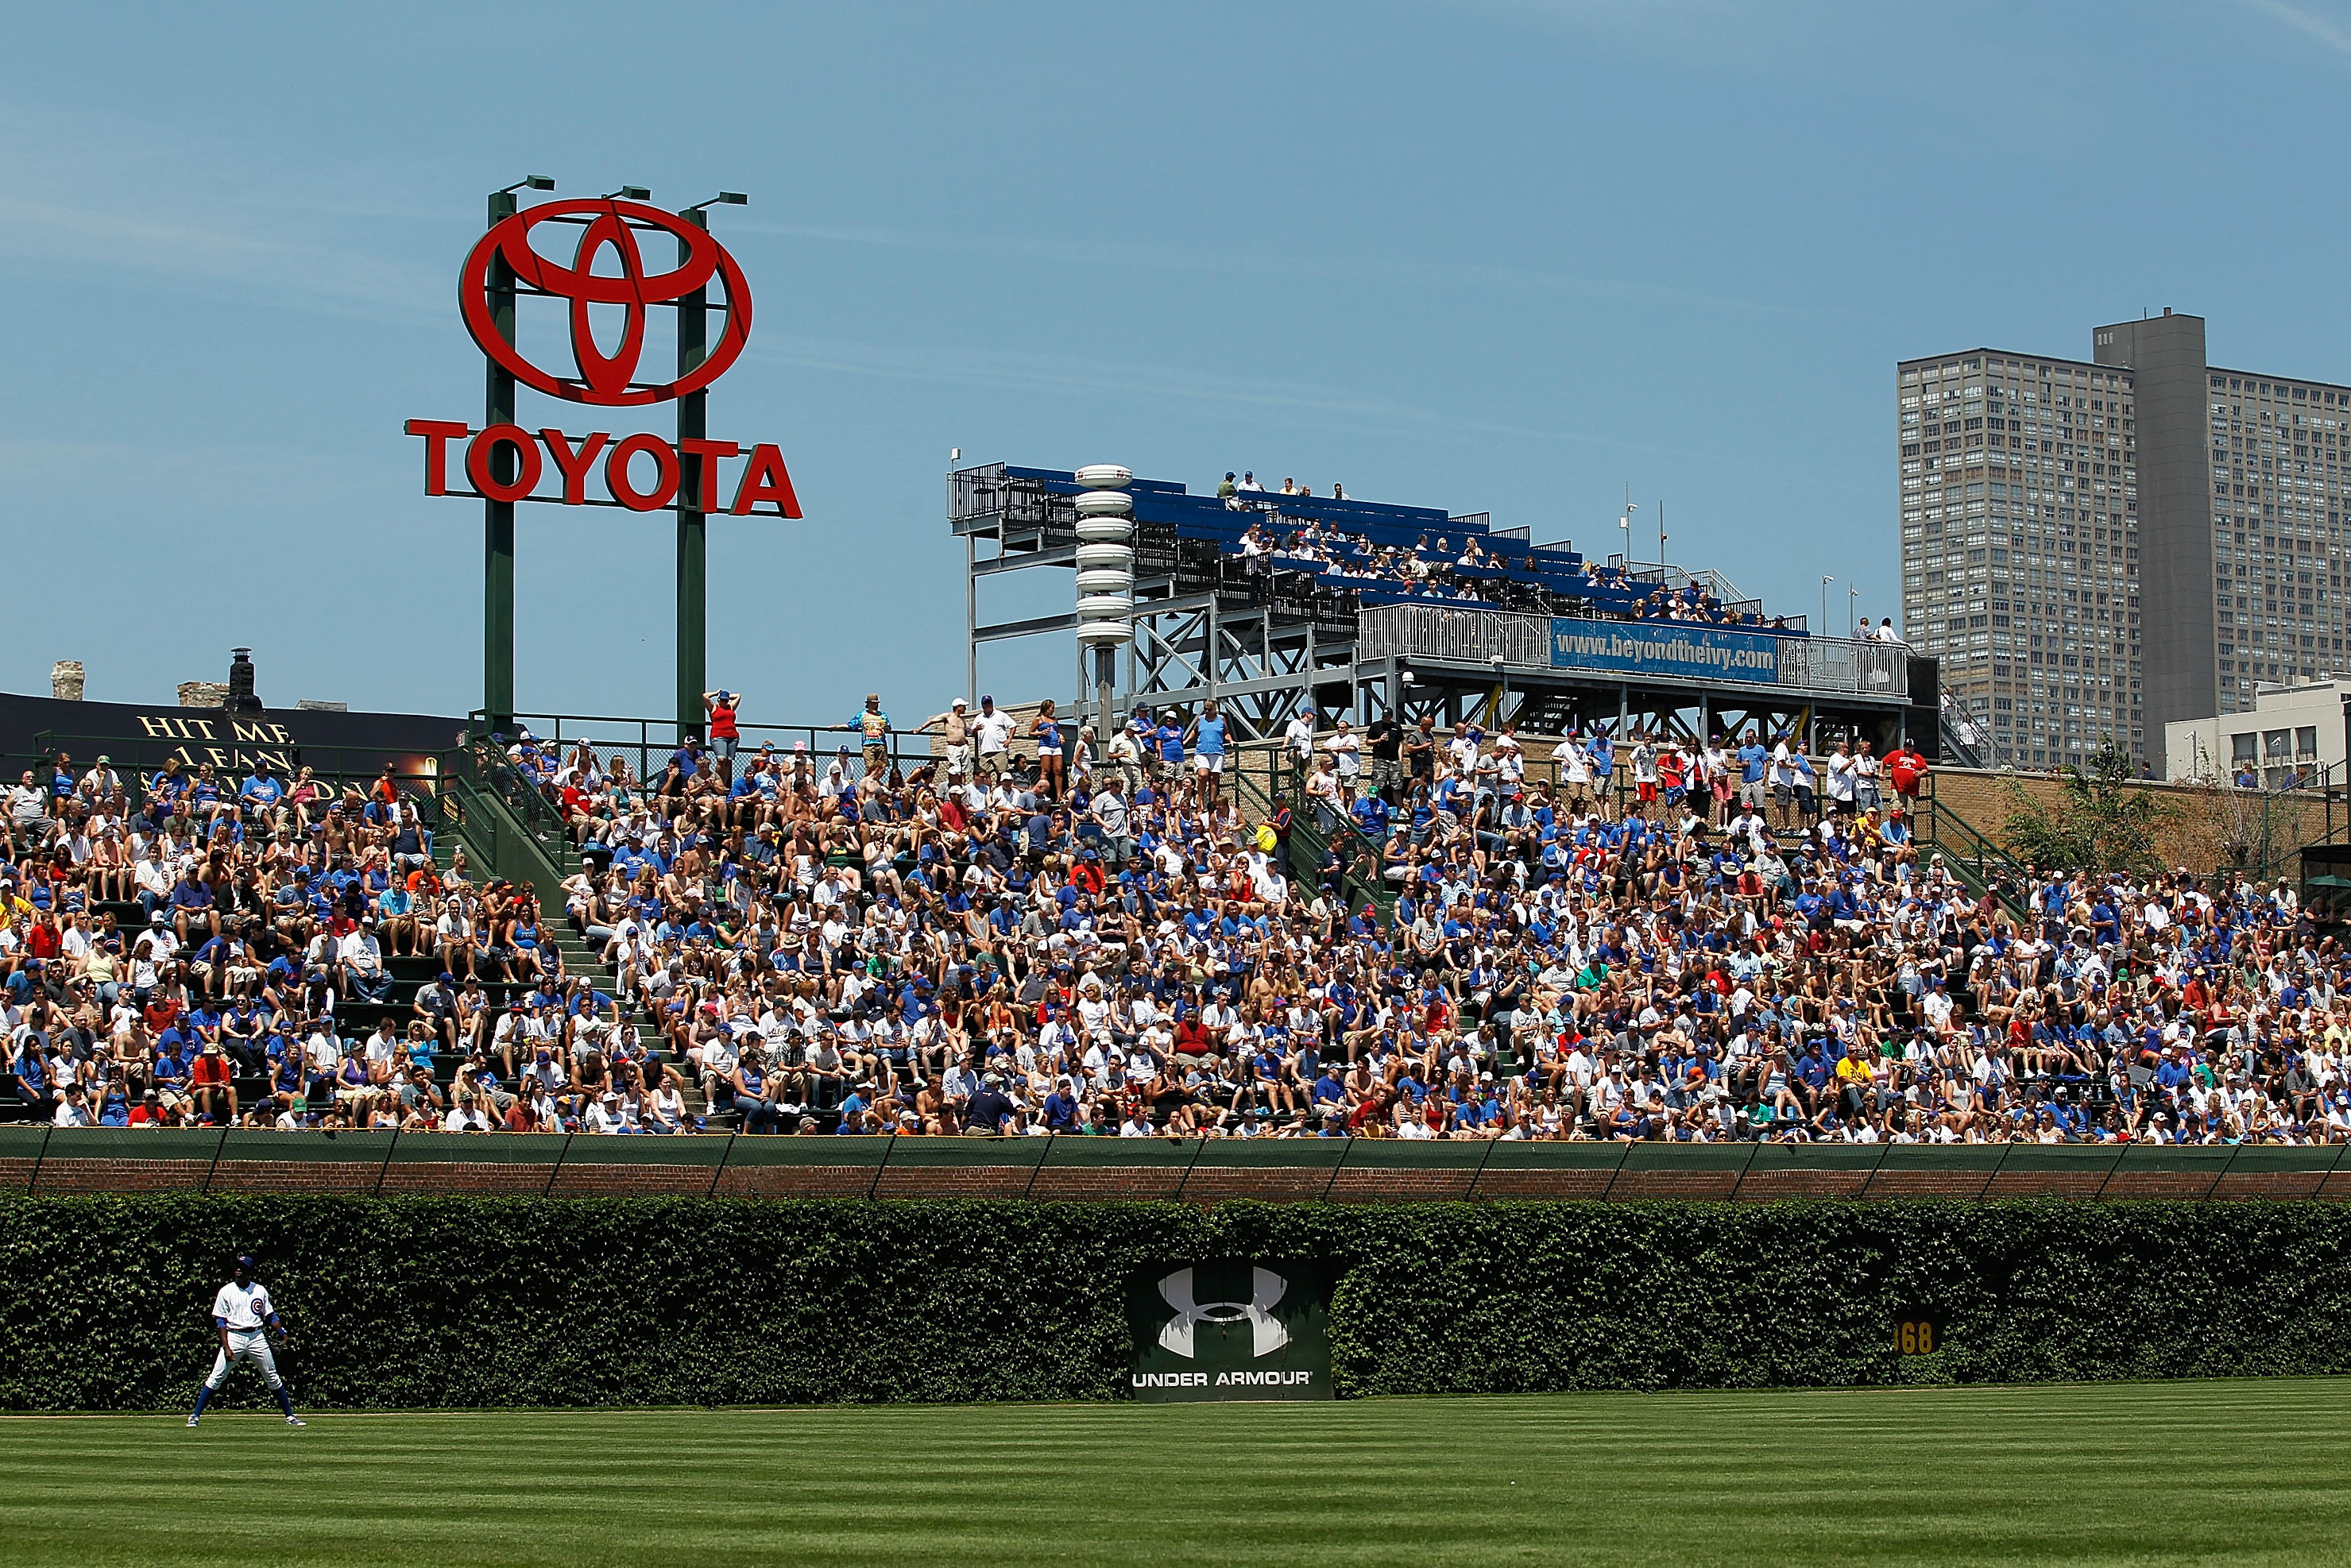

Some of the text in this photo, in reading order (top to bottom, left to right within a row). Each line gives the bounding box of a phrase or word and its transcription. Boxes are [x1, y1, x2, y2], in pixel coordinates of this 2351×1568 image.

[404, 419, 804, 519] TOYOTA
[1556, 633, 1774, 670] www.beyondtheivy.com
[136, 716, 218, 740] HIT
[1132, 1371, 1309, 1388] UNDER ARMOUR
